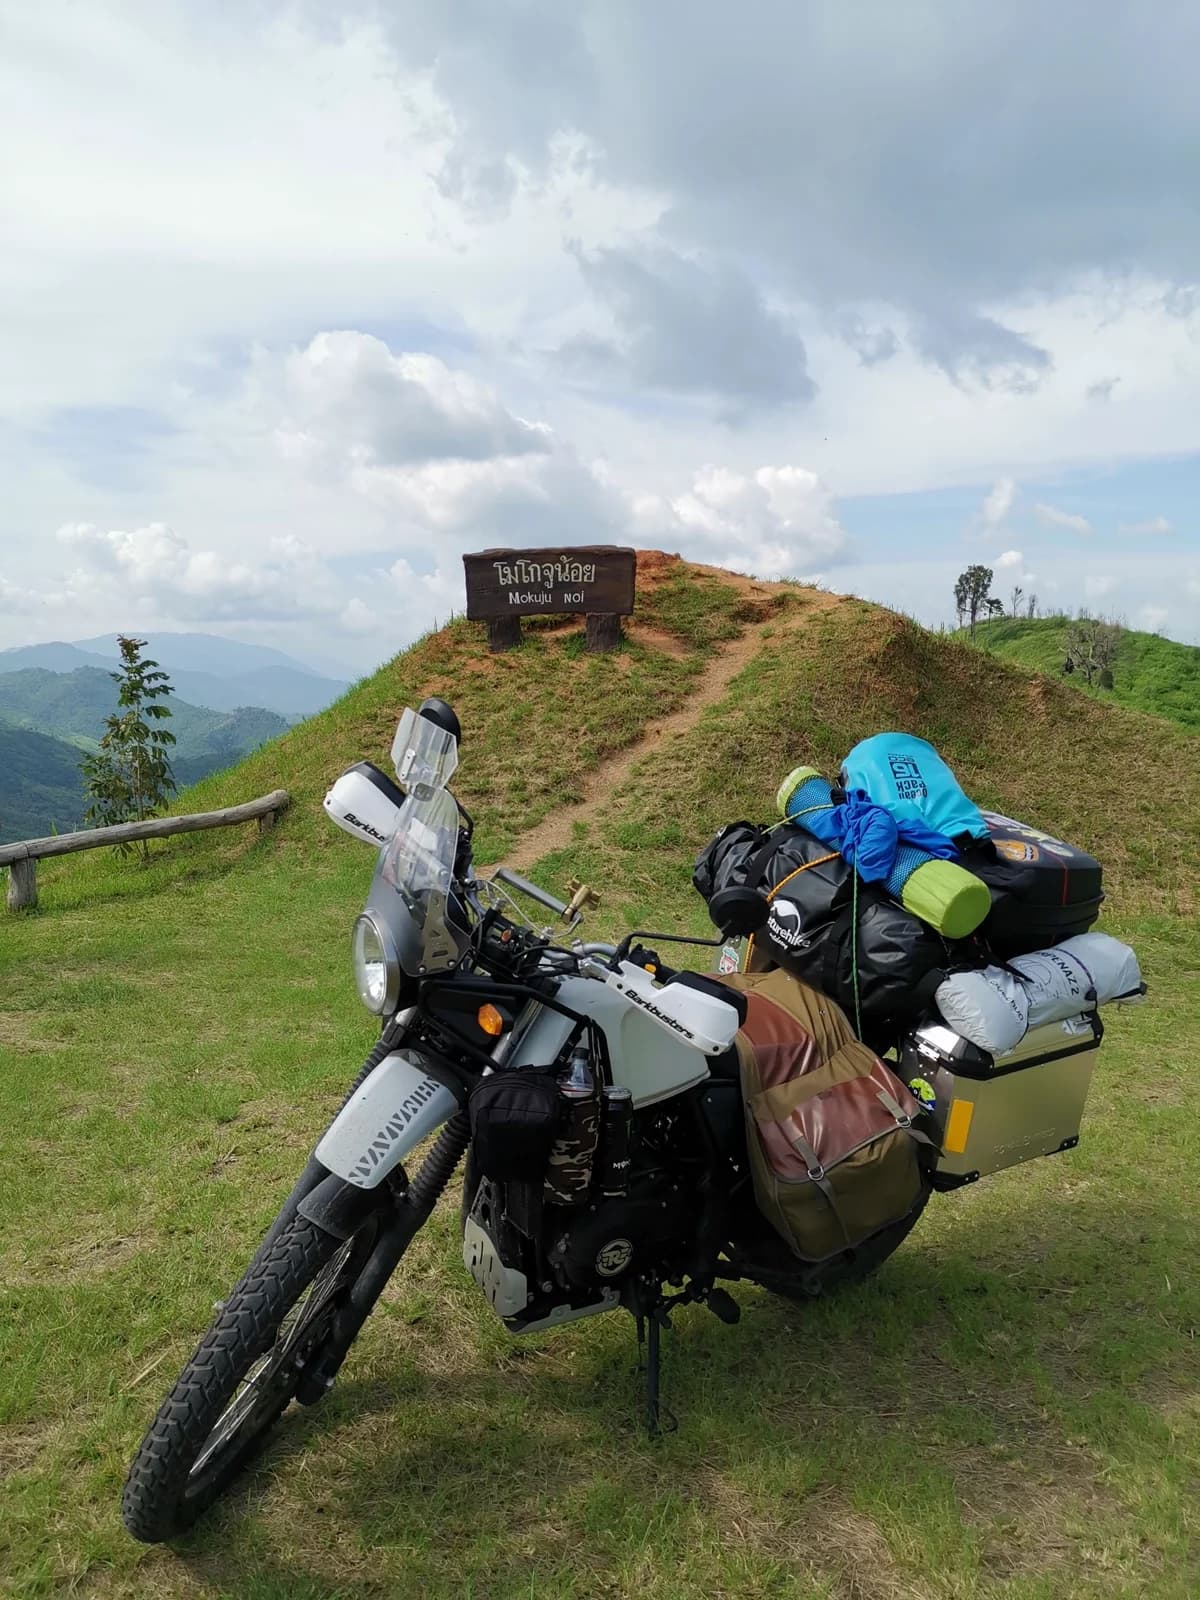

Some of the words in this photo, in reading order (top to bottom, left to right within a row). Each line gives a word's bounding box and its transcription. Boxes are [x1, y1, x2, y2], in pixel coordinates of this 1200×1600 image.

[493, 555, 596, 589] โมโกจูน้อย
[509, 591, 552, 605] Mokuju
[896, 779, 927, 791] Pack
[898, 787, 928, 800] Ocean
[1071, 987, 1080, 996] 2
[624, 989, 696, 1040] Barkbusters
